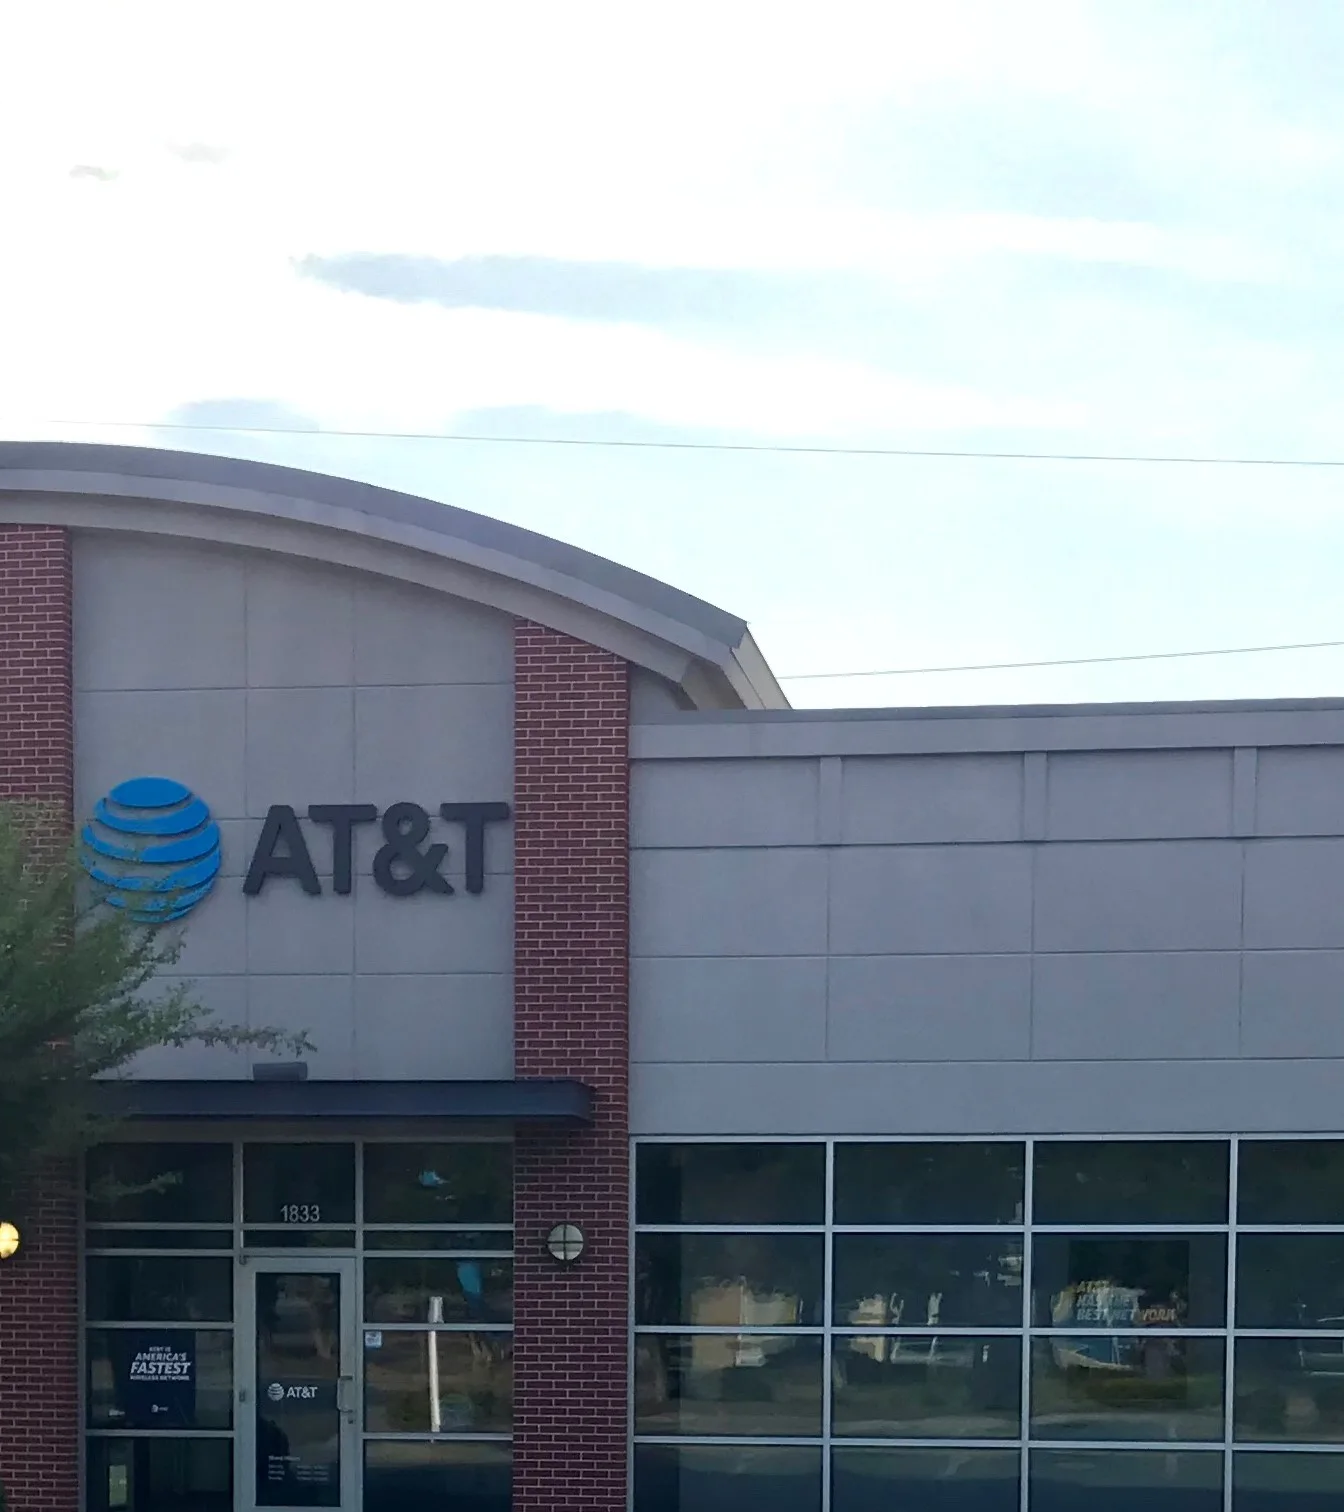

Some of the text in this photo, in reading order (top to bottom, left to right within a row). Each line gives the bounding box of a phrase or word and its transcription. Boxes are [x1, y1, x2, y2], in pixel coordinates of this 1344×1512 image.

[243, 802, 509, 896] AT&T
[280, 1204, 320, 1222] 1833
[130, 1361, 192, 1374] FASTEST
[286, 1386, 318, 1398] AT&T
